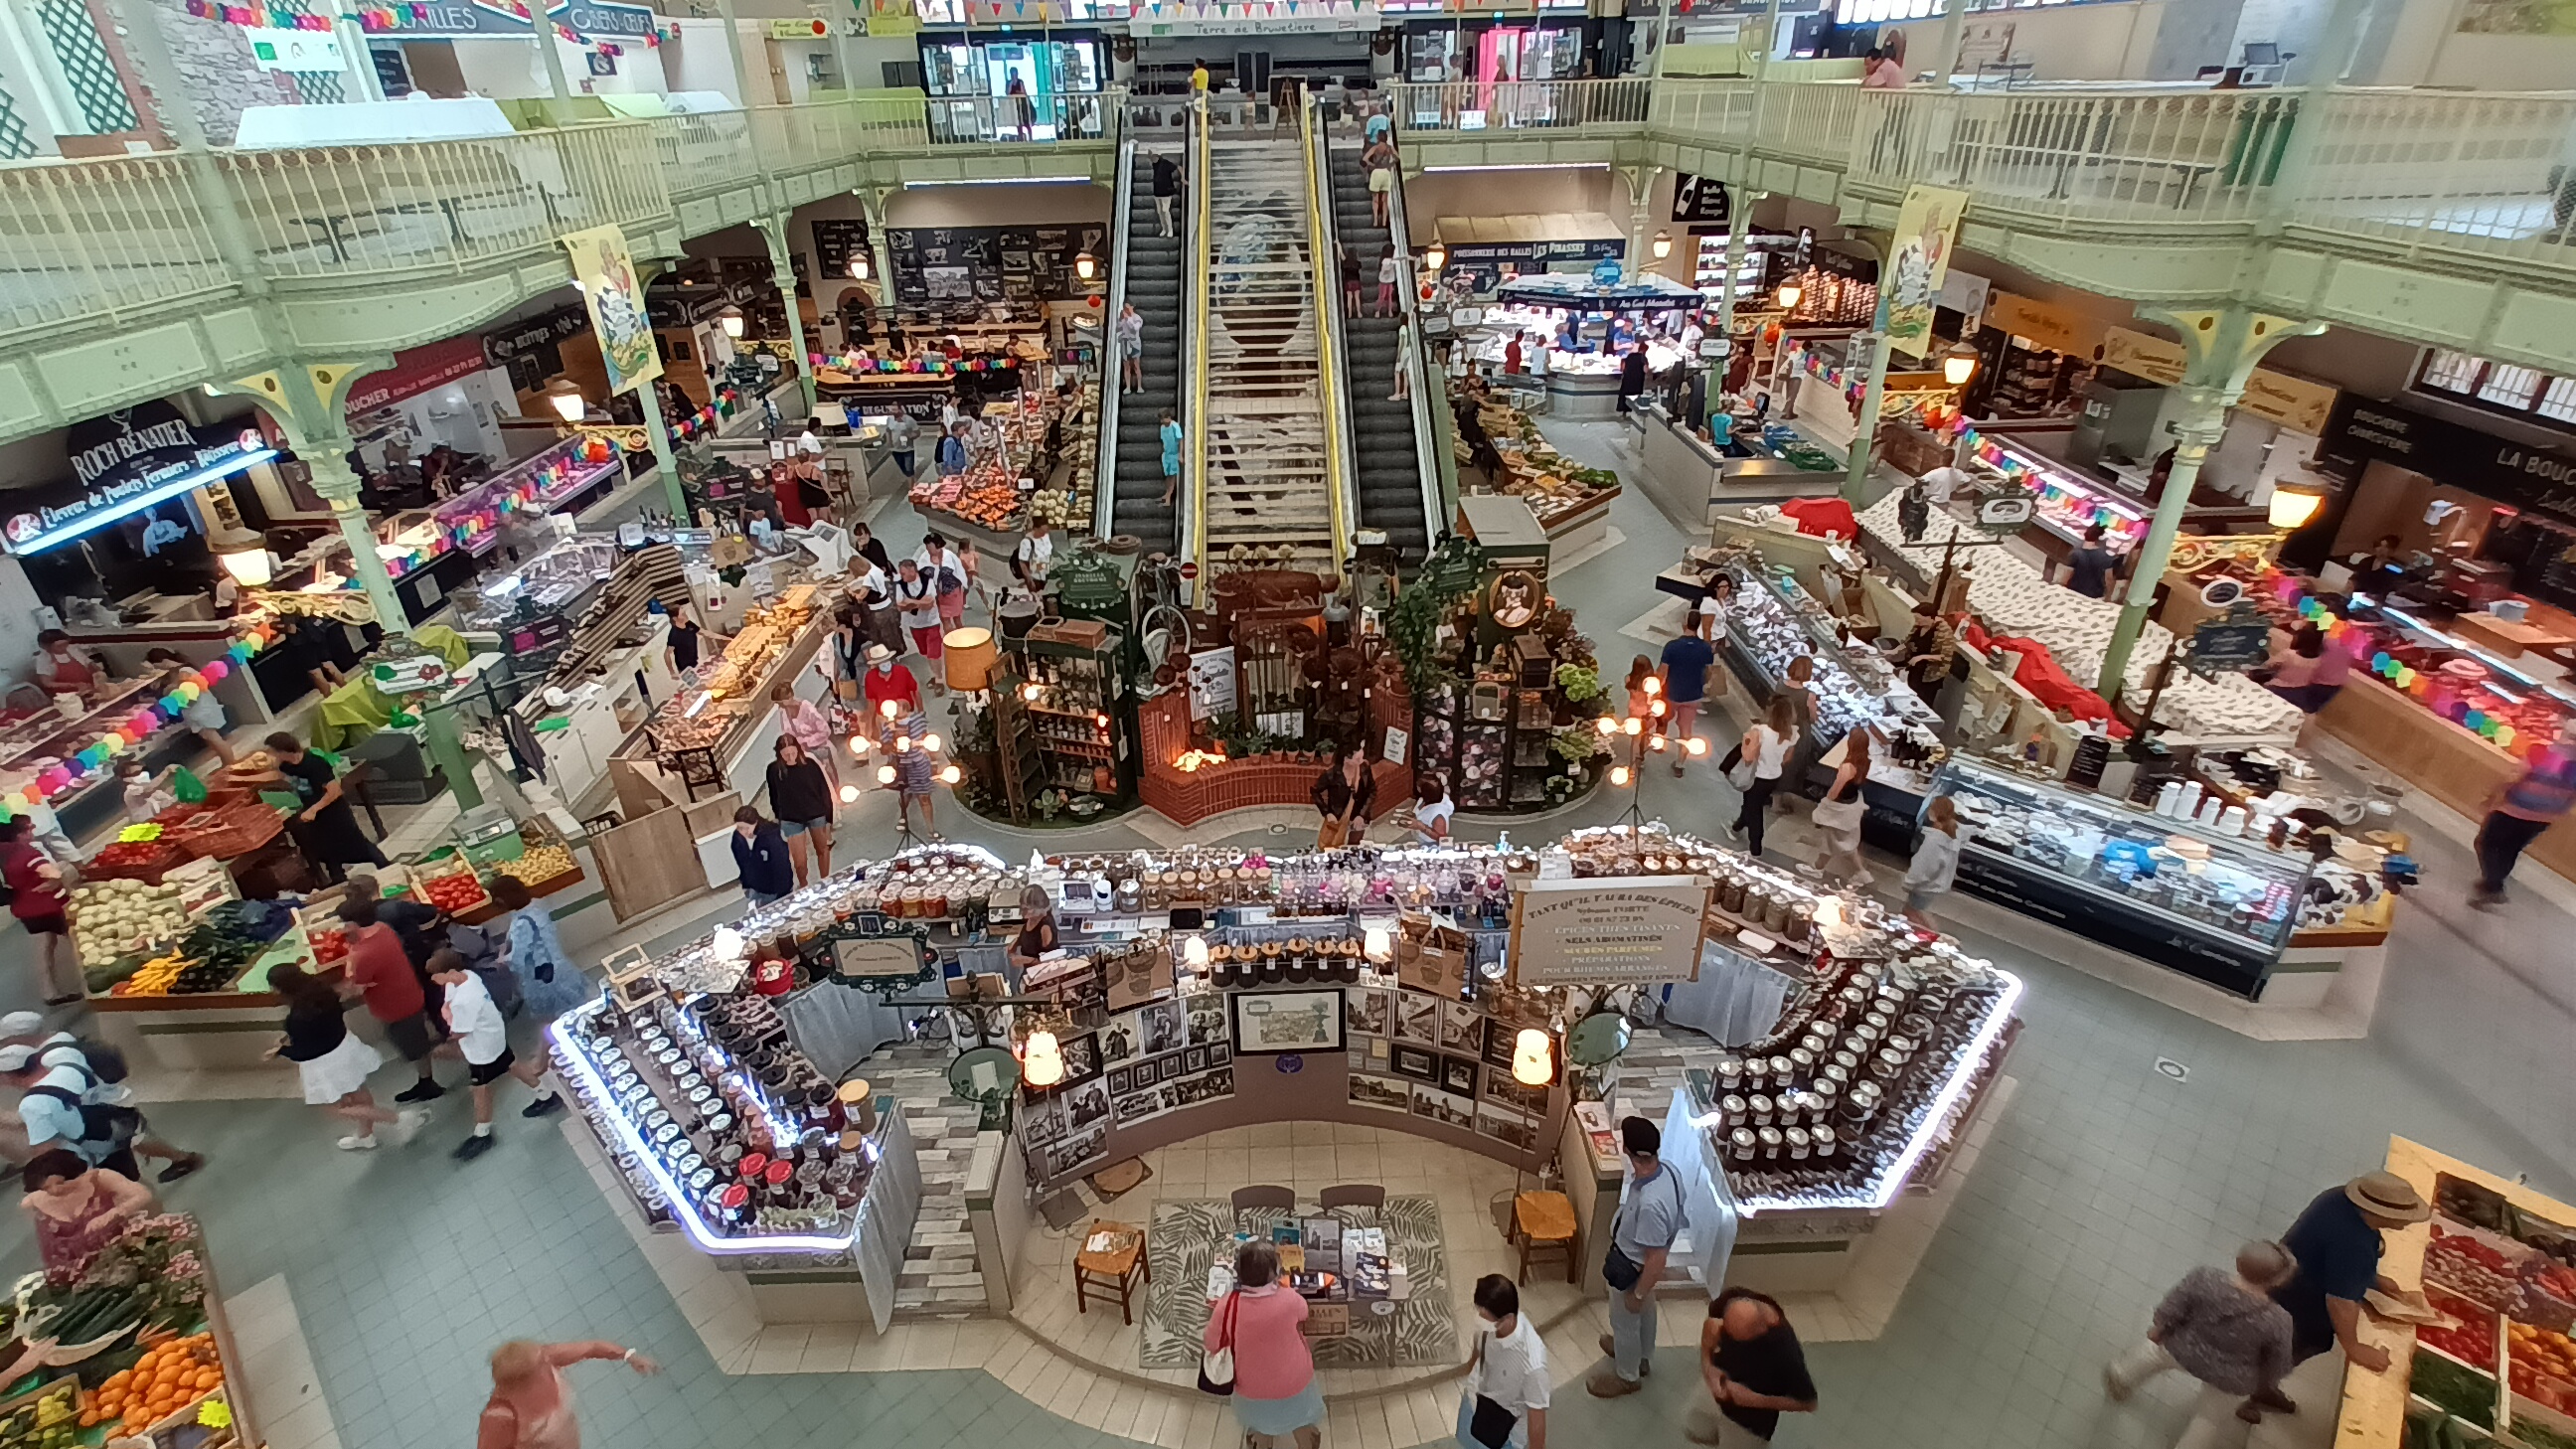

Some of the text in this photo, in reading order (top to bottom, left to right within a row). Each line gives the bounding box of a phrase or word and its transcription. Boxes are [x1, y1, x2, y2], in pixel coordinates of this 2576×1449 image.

[1195, 22, 1227, 35] Terre
[1234, 22, 1249, 34] de
[345, 389, 391, 415] OUCHER
[2353, 408, 2408, 434] BOUCHERIE
[71, 418, 198, 486] ROCH BÉNATIER
[2496, 447, 2521, 468] LA
[88, 491, 104, 507] de
[1528, 902, 1558, 919] TANT
[1634, 893, 1659, 903] DES
